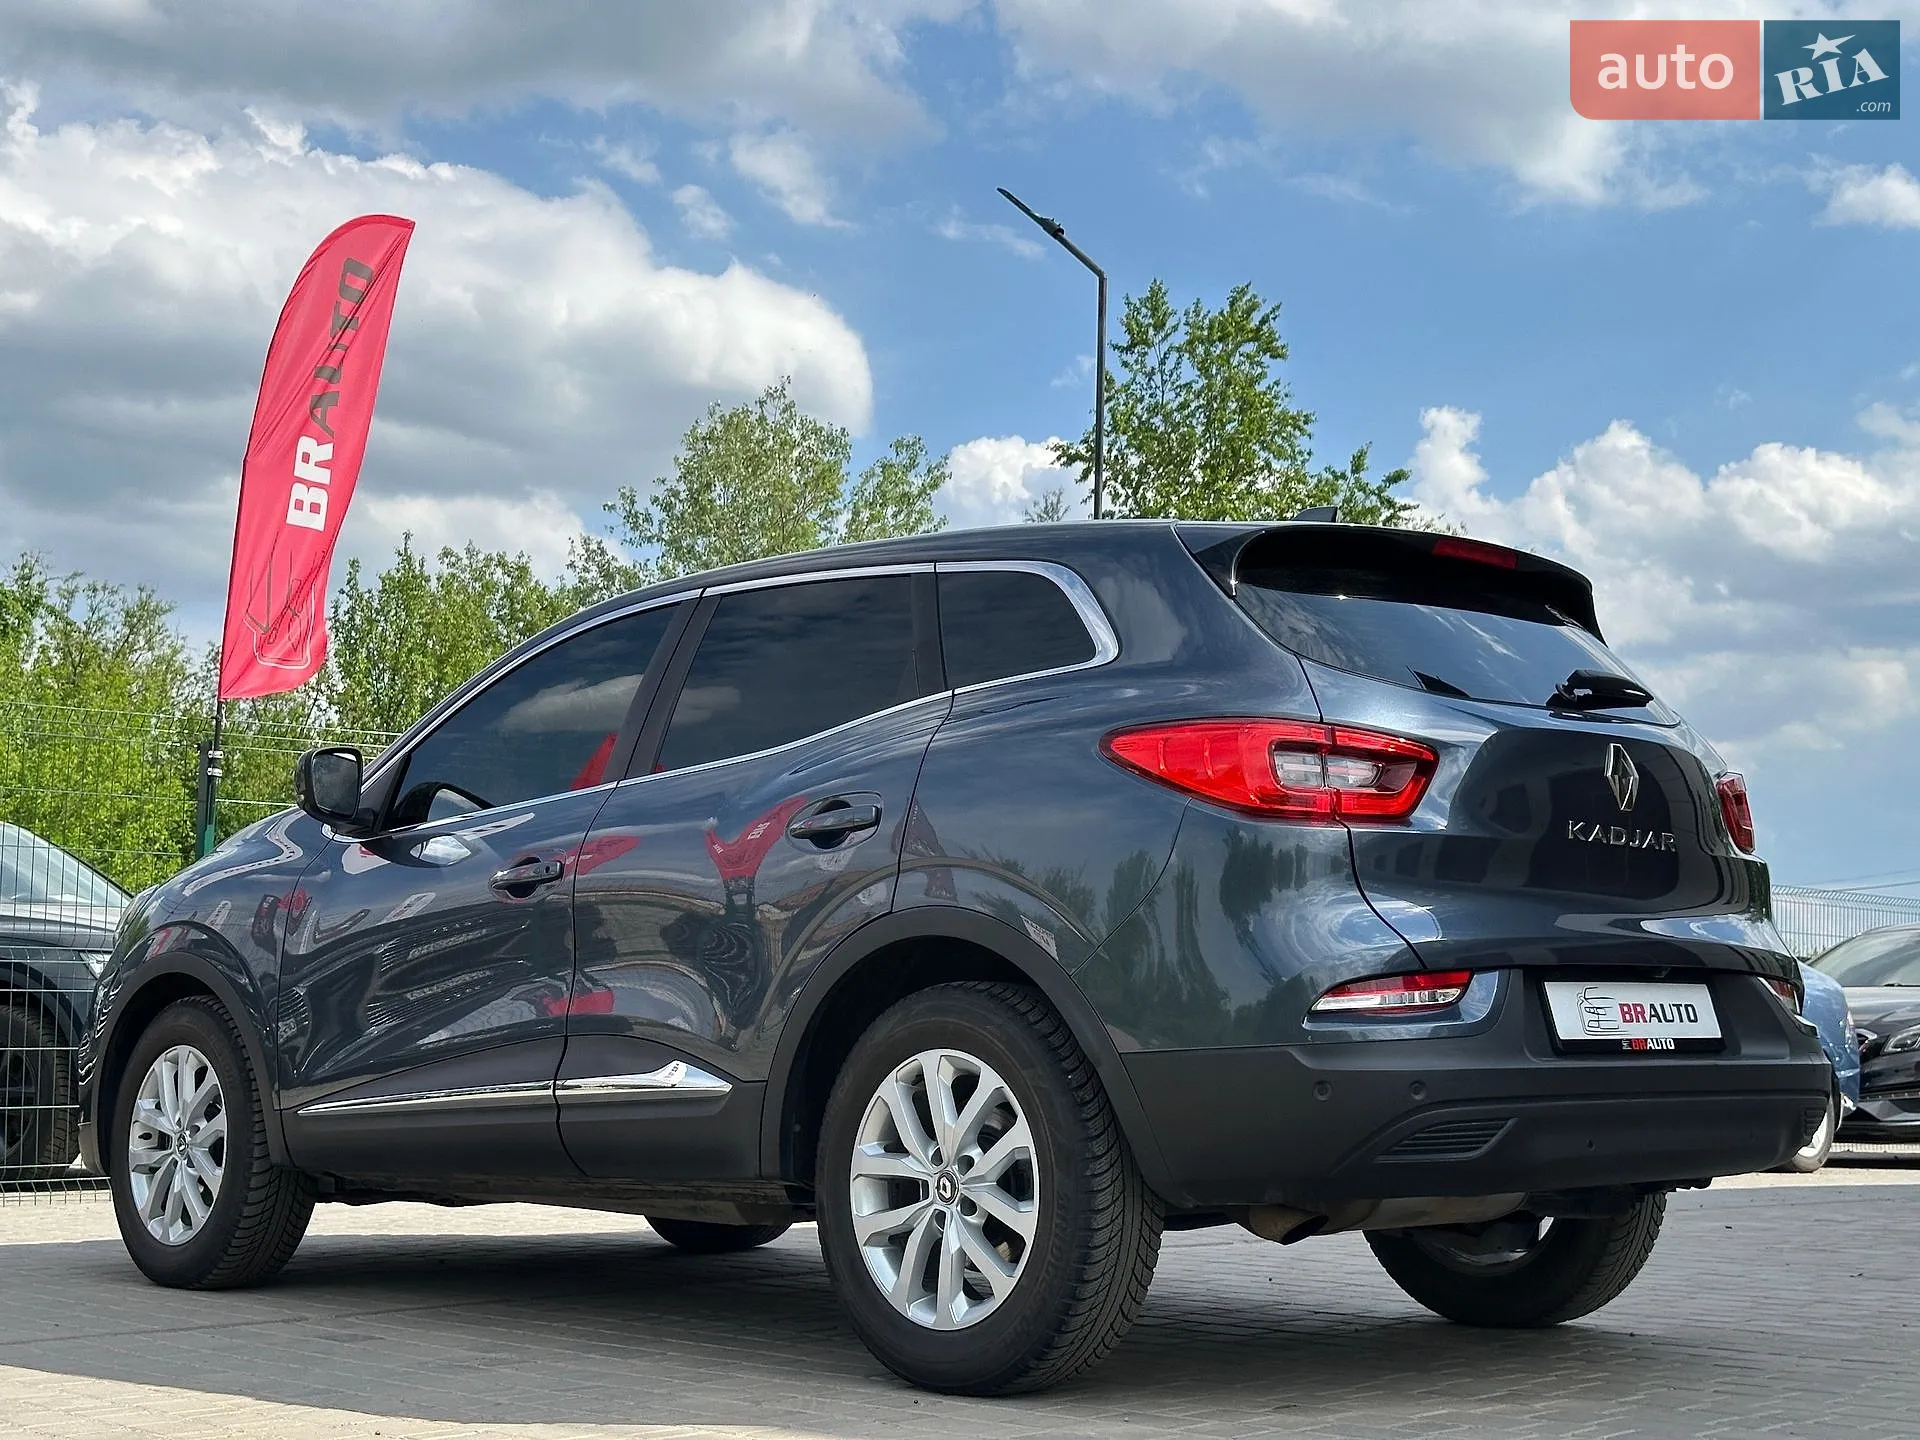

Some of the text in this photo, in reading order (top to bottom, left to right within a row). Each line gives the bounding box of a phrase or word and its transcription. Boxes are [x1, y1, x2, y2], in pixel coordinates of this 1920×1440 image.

[1568, 820, 1676, 852] KADJAR
[1618, 1003, 1698, 1024] BRAUTO
[1632, 1037, 1675, 1050] BRAUTO
